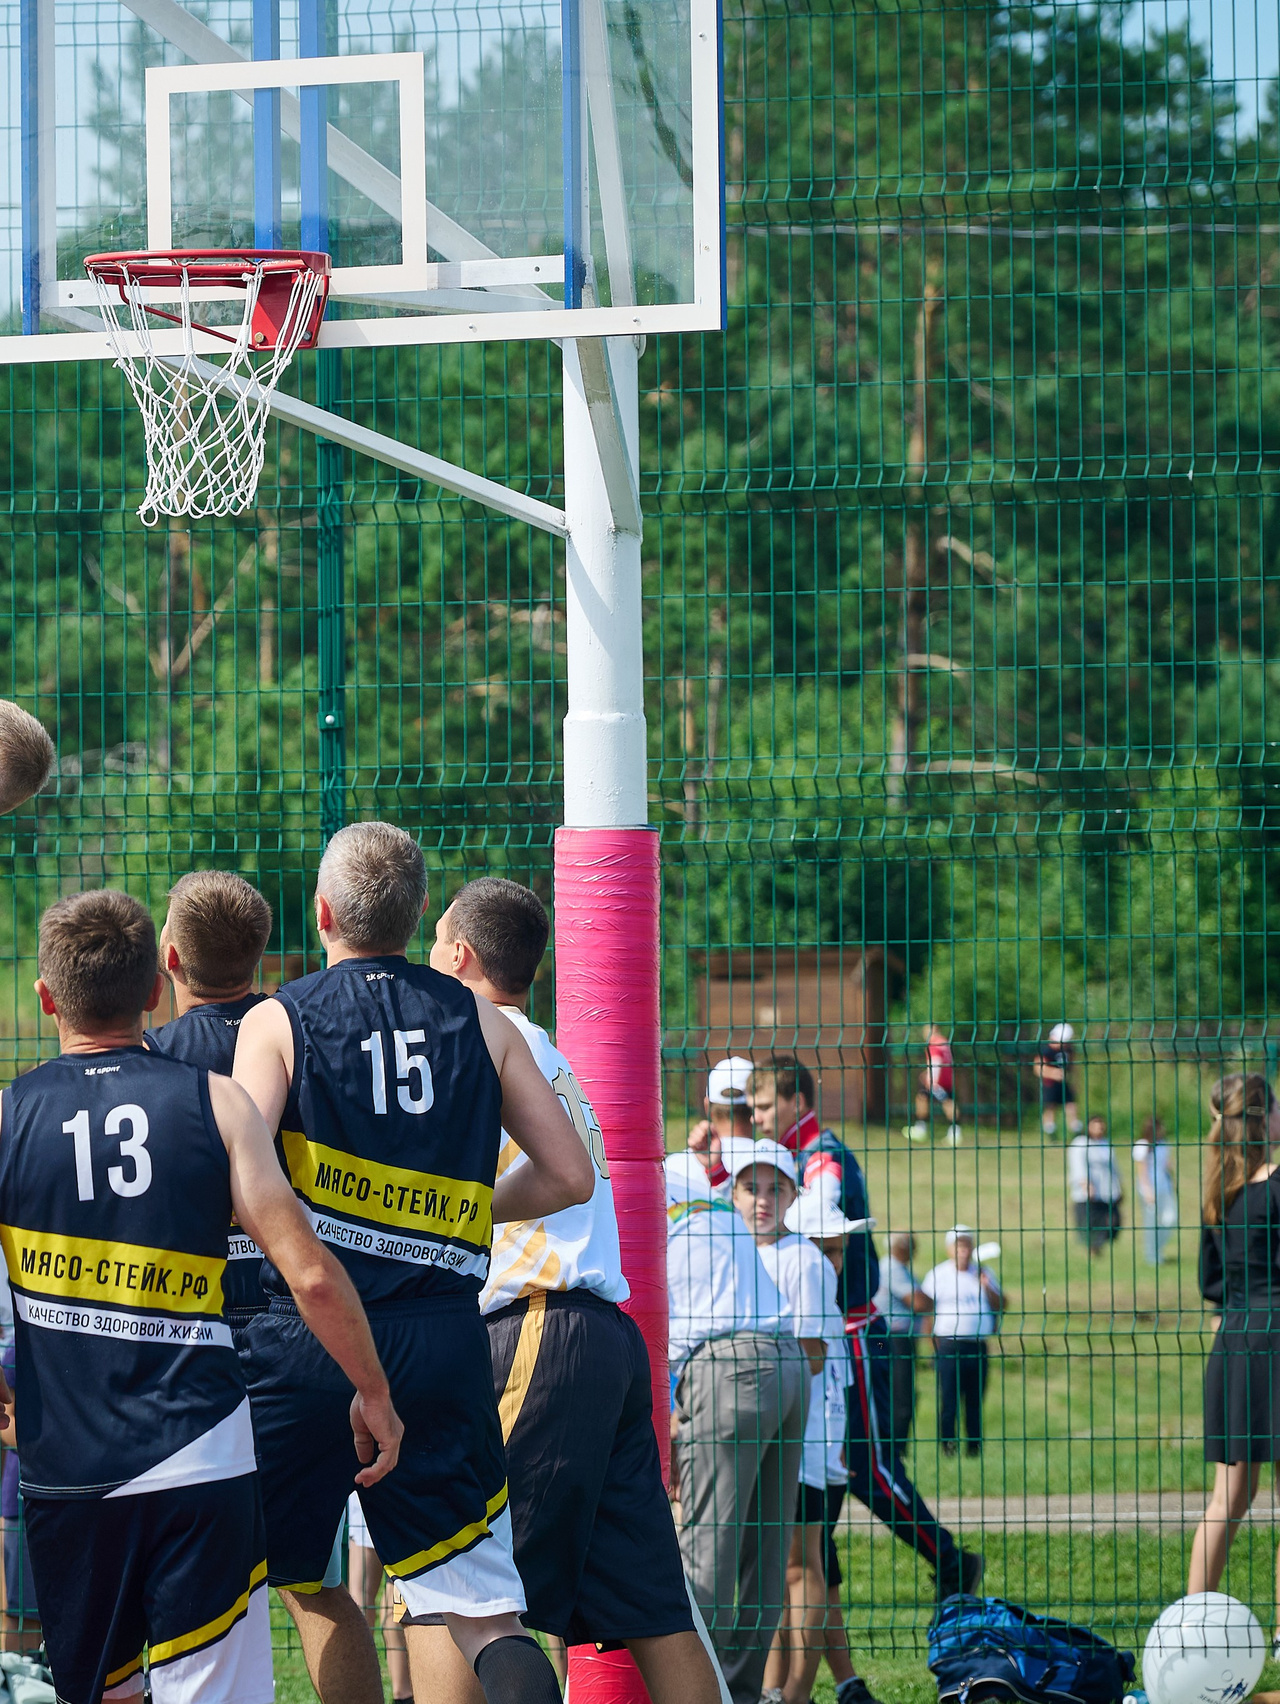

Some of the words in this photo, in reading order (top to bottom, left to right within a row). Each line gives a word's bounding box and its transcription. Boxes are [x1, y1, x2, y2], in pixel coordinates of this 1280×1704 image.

[361, 1029, 435, 1115] 15
[62, 1104, 152, 1201] 13
[228, 1240, 256, 1255] СТВО
[316, 1220, 373, 1248] КАЧЕСТВО
[376, 1238, 439, 1263] ЗДОРОВО
[21, 1247, 208, 1299] МЯСО-СТЕЙК.РФ
[28, 1304, 90, 1328] КАЧЕСТВО
[94, 1316, 165, 1338] ЗДОРОВОЙ
[169, 1325, 213, 1341] ЖИЗНИ
